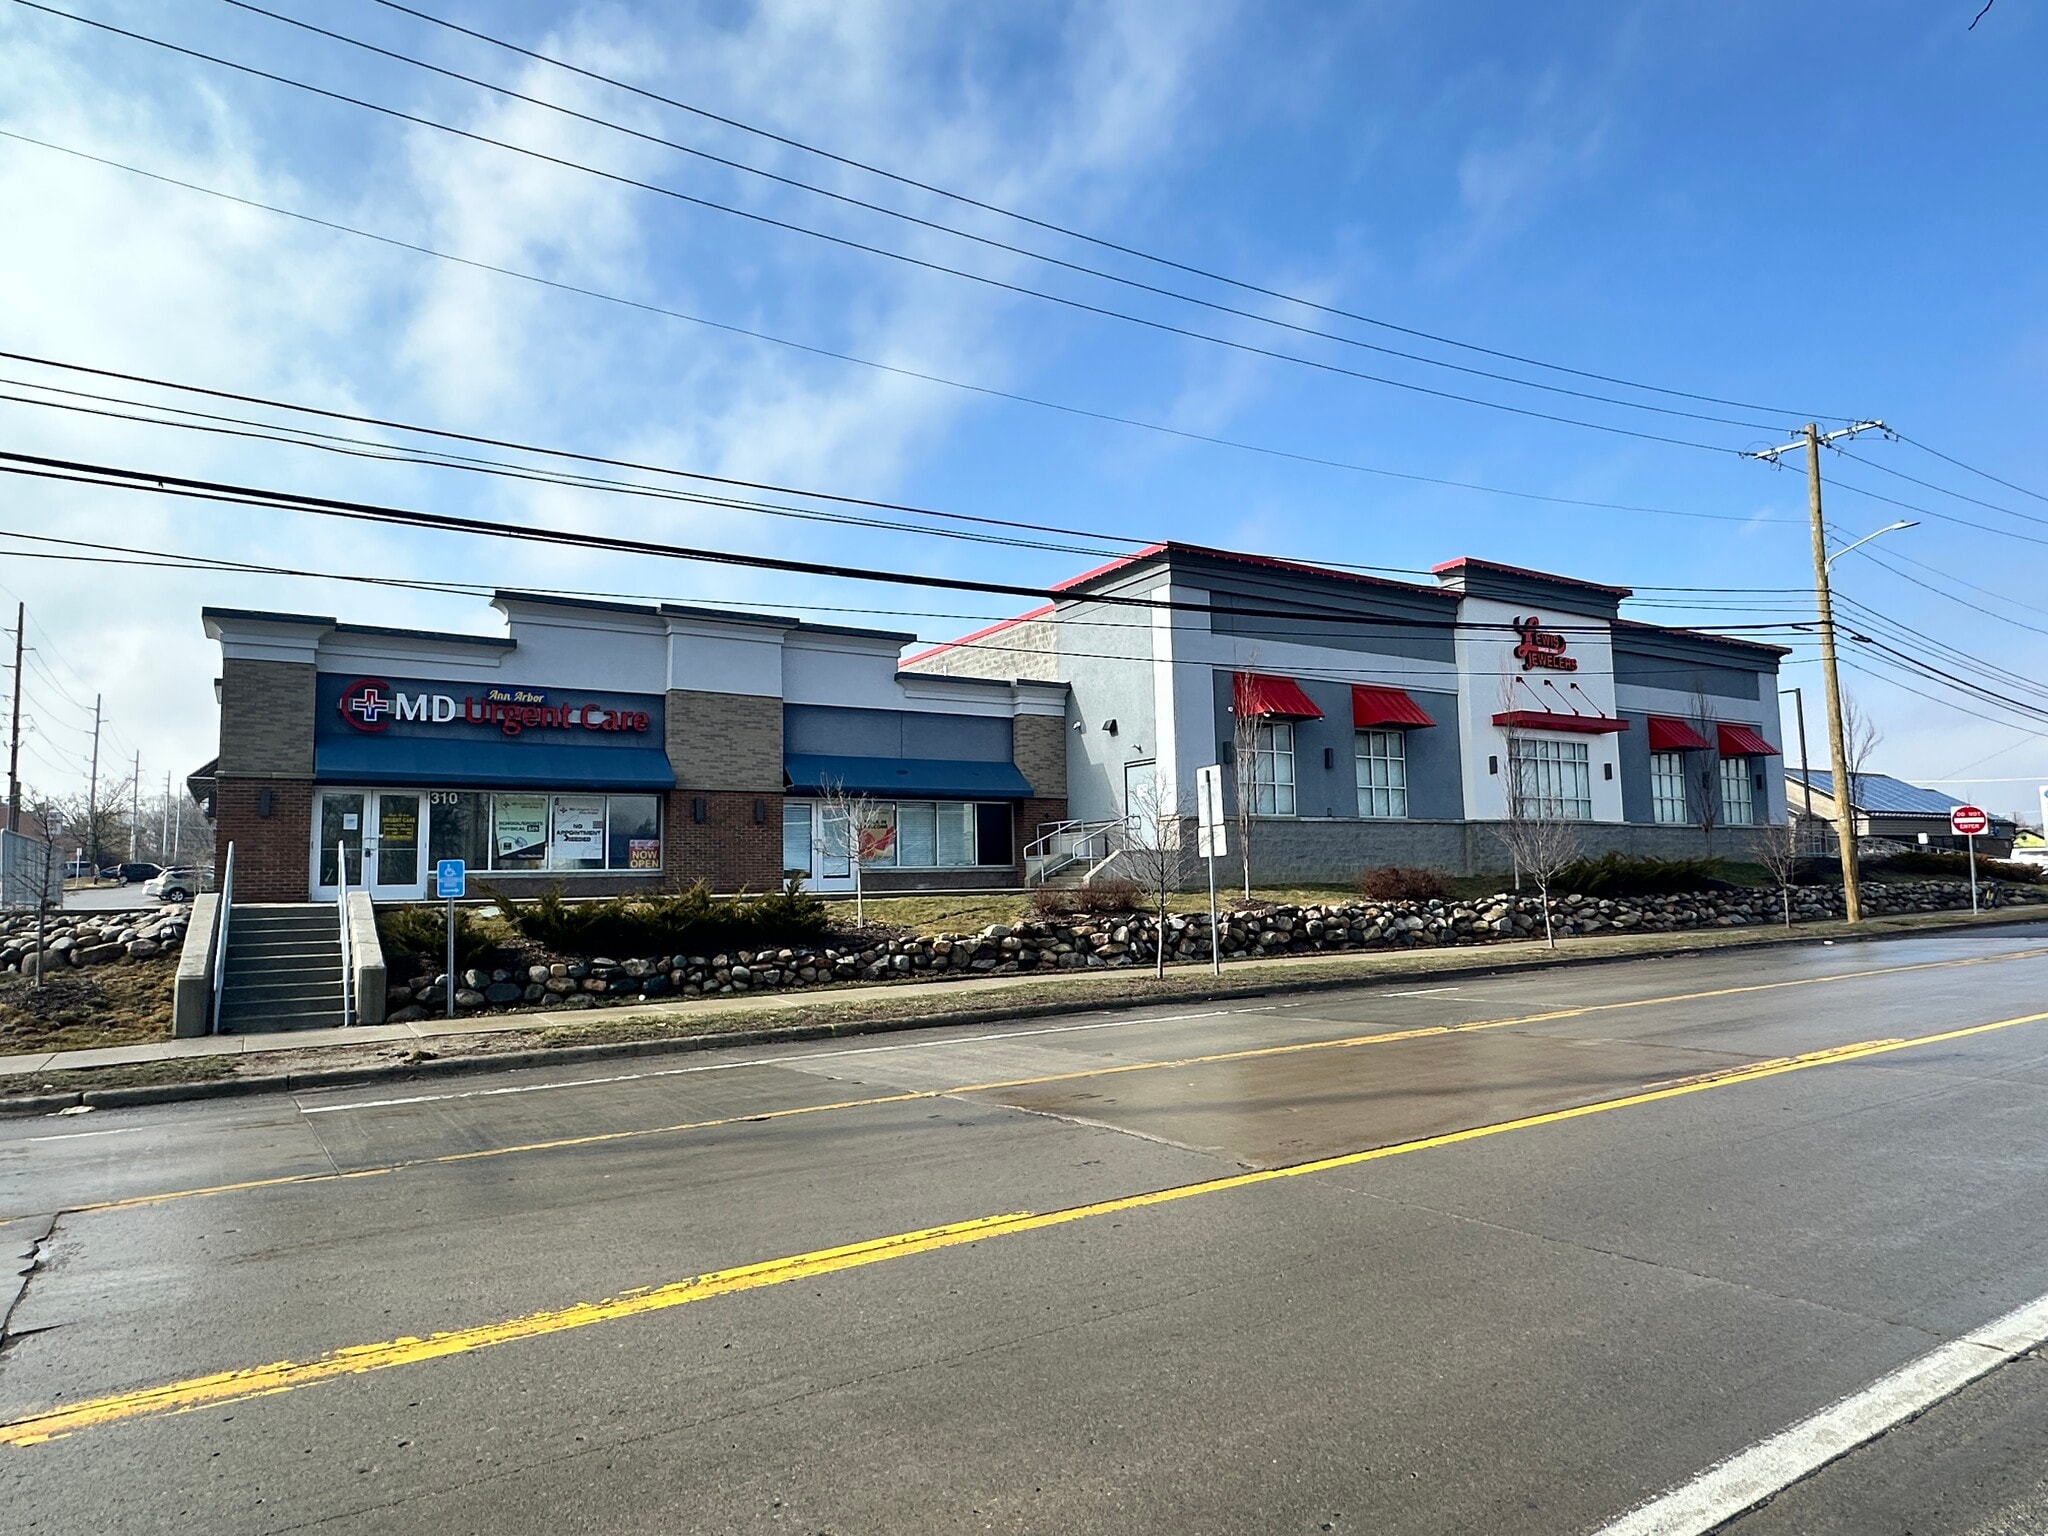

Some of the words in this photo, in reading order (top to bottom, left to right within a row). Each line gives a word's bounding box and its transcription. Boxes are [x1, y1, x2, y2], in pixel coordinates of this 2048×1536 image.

[1525, 653, 1577, 670] JEWELERS
[488, 690, 510, 701] Ann
[514, 691, 545, 703] Arbor
[395, 692, 457, 723] MD
[465, 697, 572, 735] Urgent
[580, 703, 649, 732] Care
[430, 792, 458, 804] 310
[632, 850, 658, 860] NOW
[630, 859, 659, 868] OPEN
